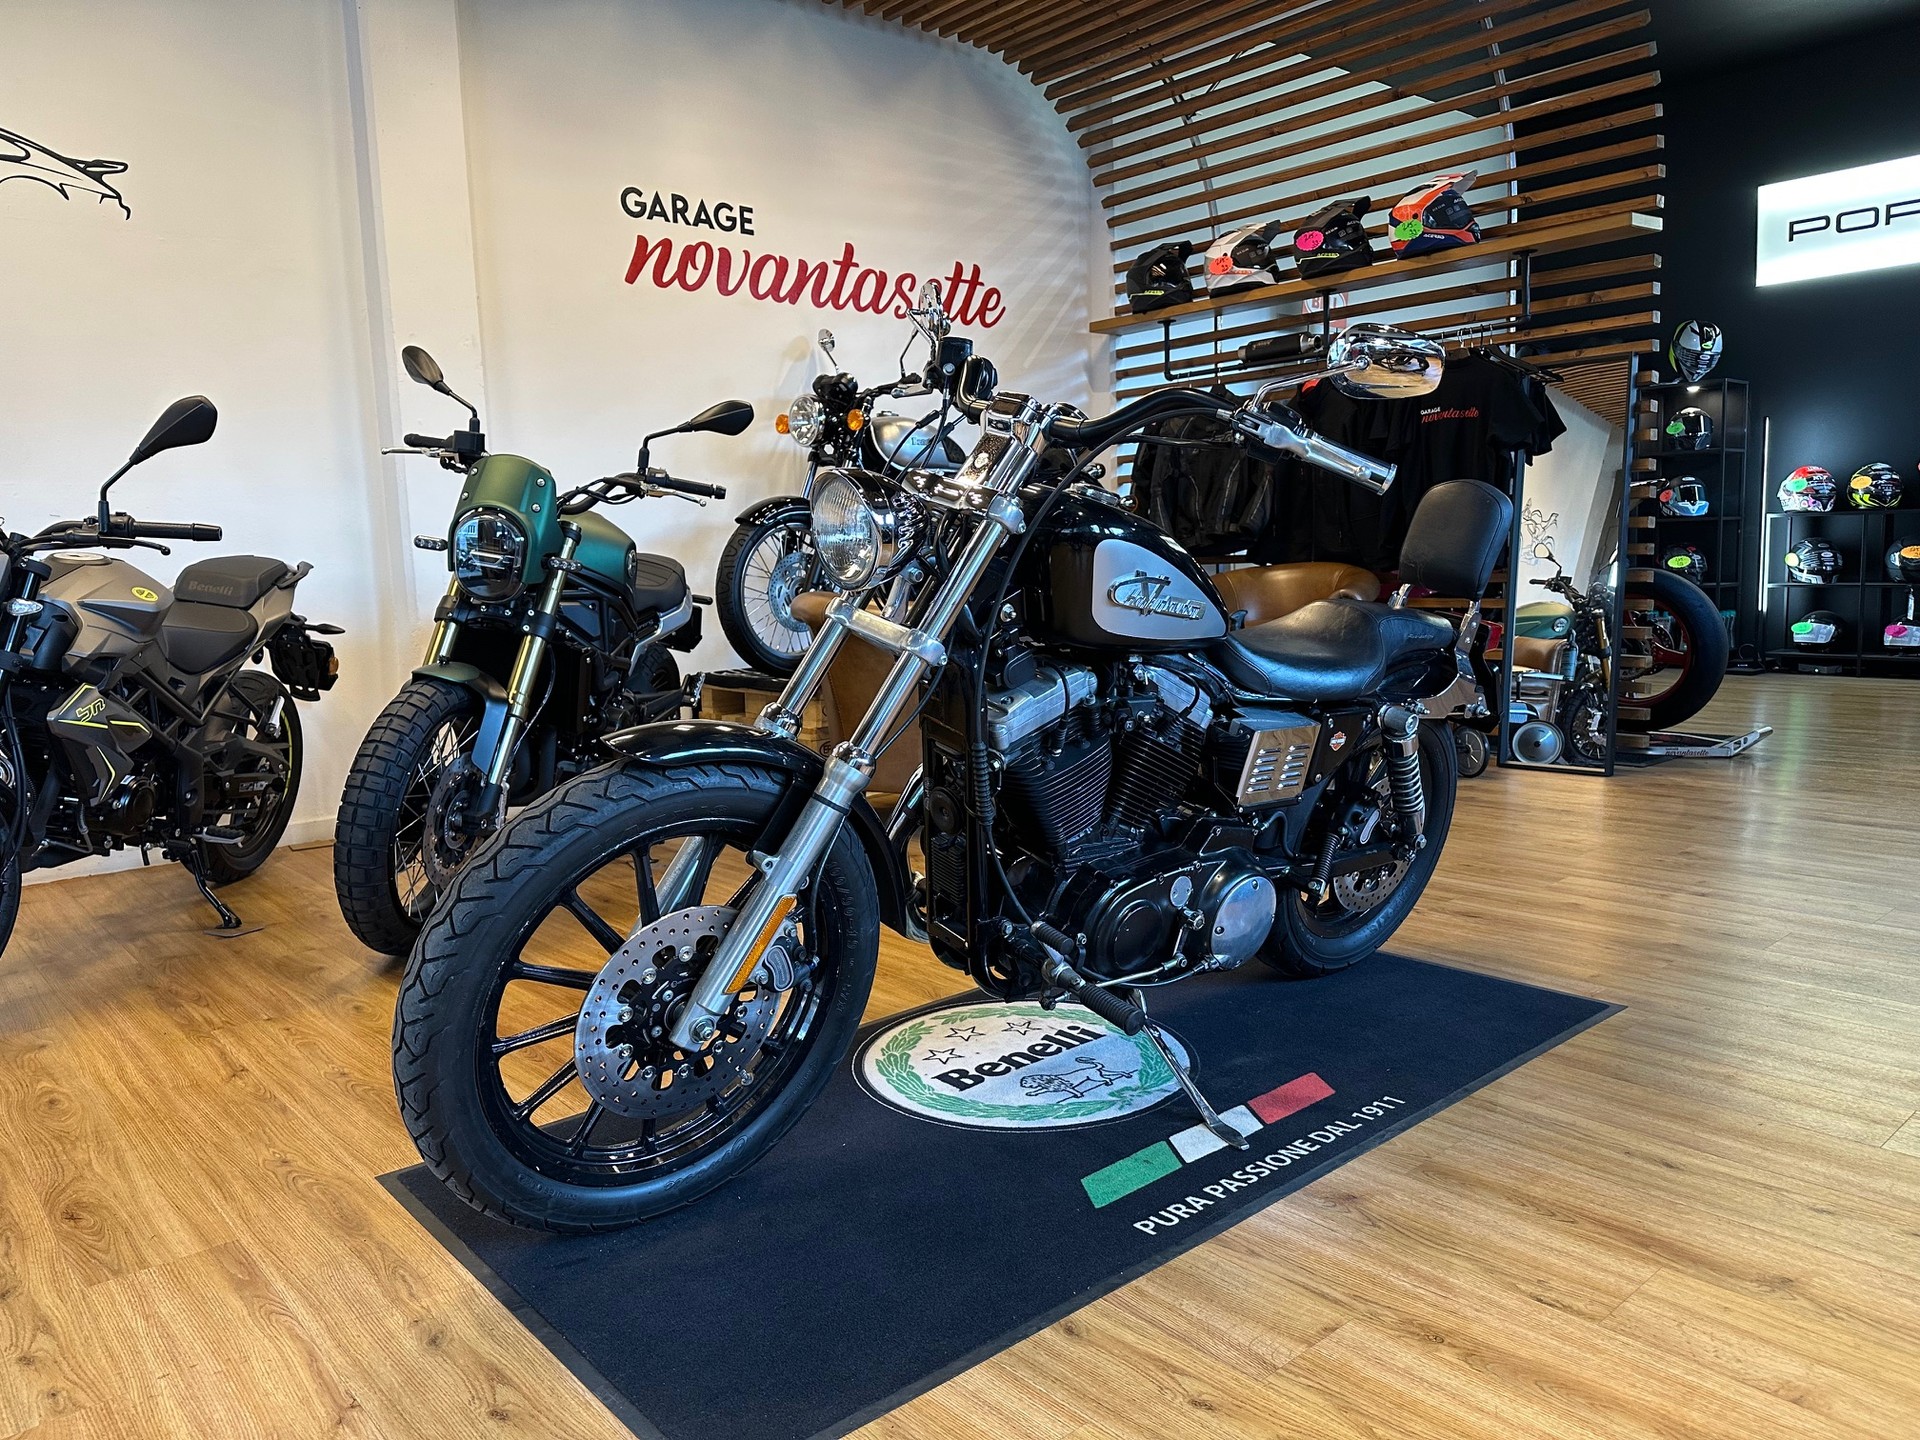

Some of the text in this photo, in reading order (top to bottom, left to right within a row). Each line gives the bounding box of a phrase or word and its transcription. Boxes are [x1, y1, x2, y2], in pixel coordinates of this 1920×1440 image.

[620, 186, 755, 236] GARAGE
[624, 234, 1007, 329] novantastte
[1420, 406, 1441, 415] GARAGE
[931, 1025, 1107, 1092] Benelli
[1133, 1095, 1406, 1235] PURA PASSIONE DAL 1911
